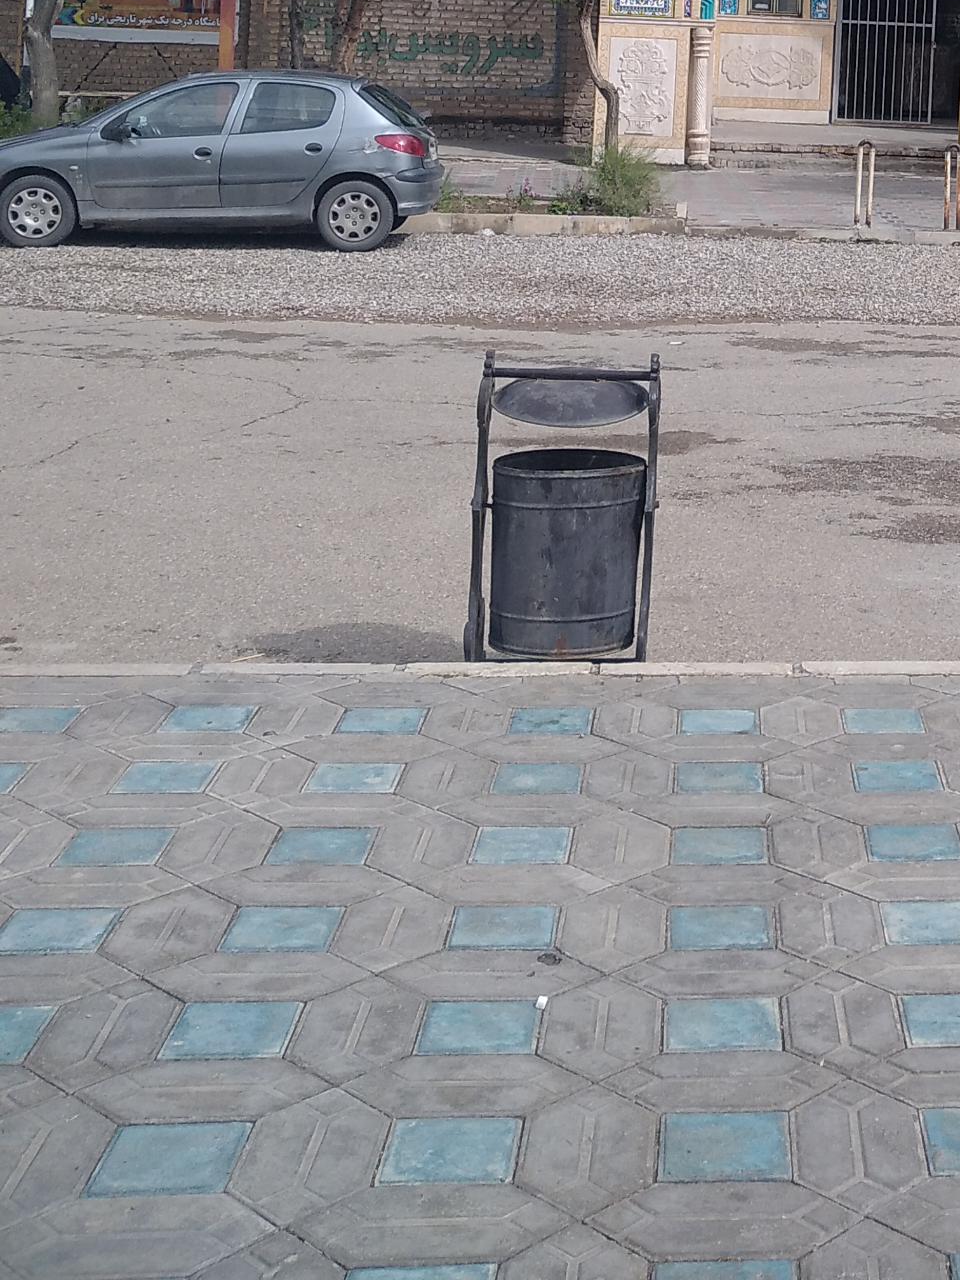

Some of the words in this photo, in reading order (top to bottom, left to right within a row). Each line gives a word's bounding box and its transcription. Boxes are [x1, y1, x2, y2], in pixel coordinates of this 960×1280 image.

[107, 14, 136, 26] تاریخی
[138, 15, 153, 25] شهر
[155, 15, 169, 26] یک
[171, 18, 192, 27] درجه
[390, 32, 544, 76] سرویس
